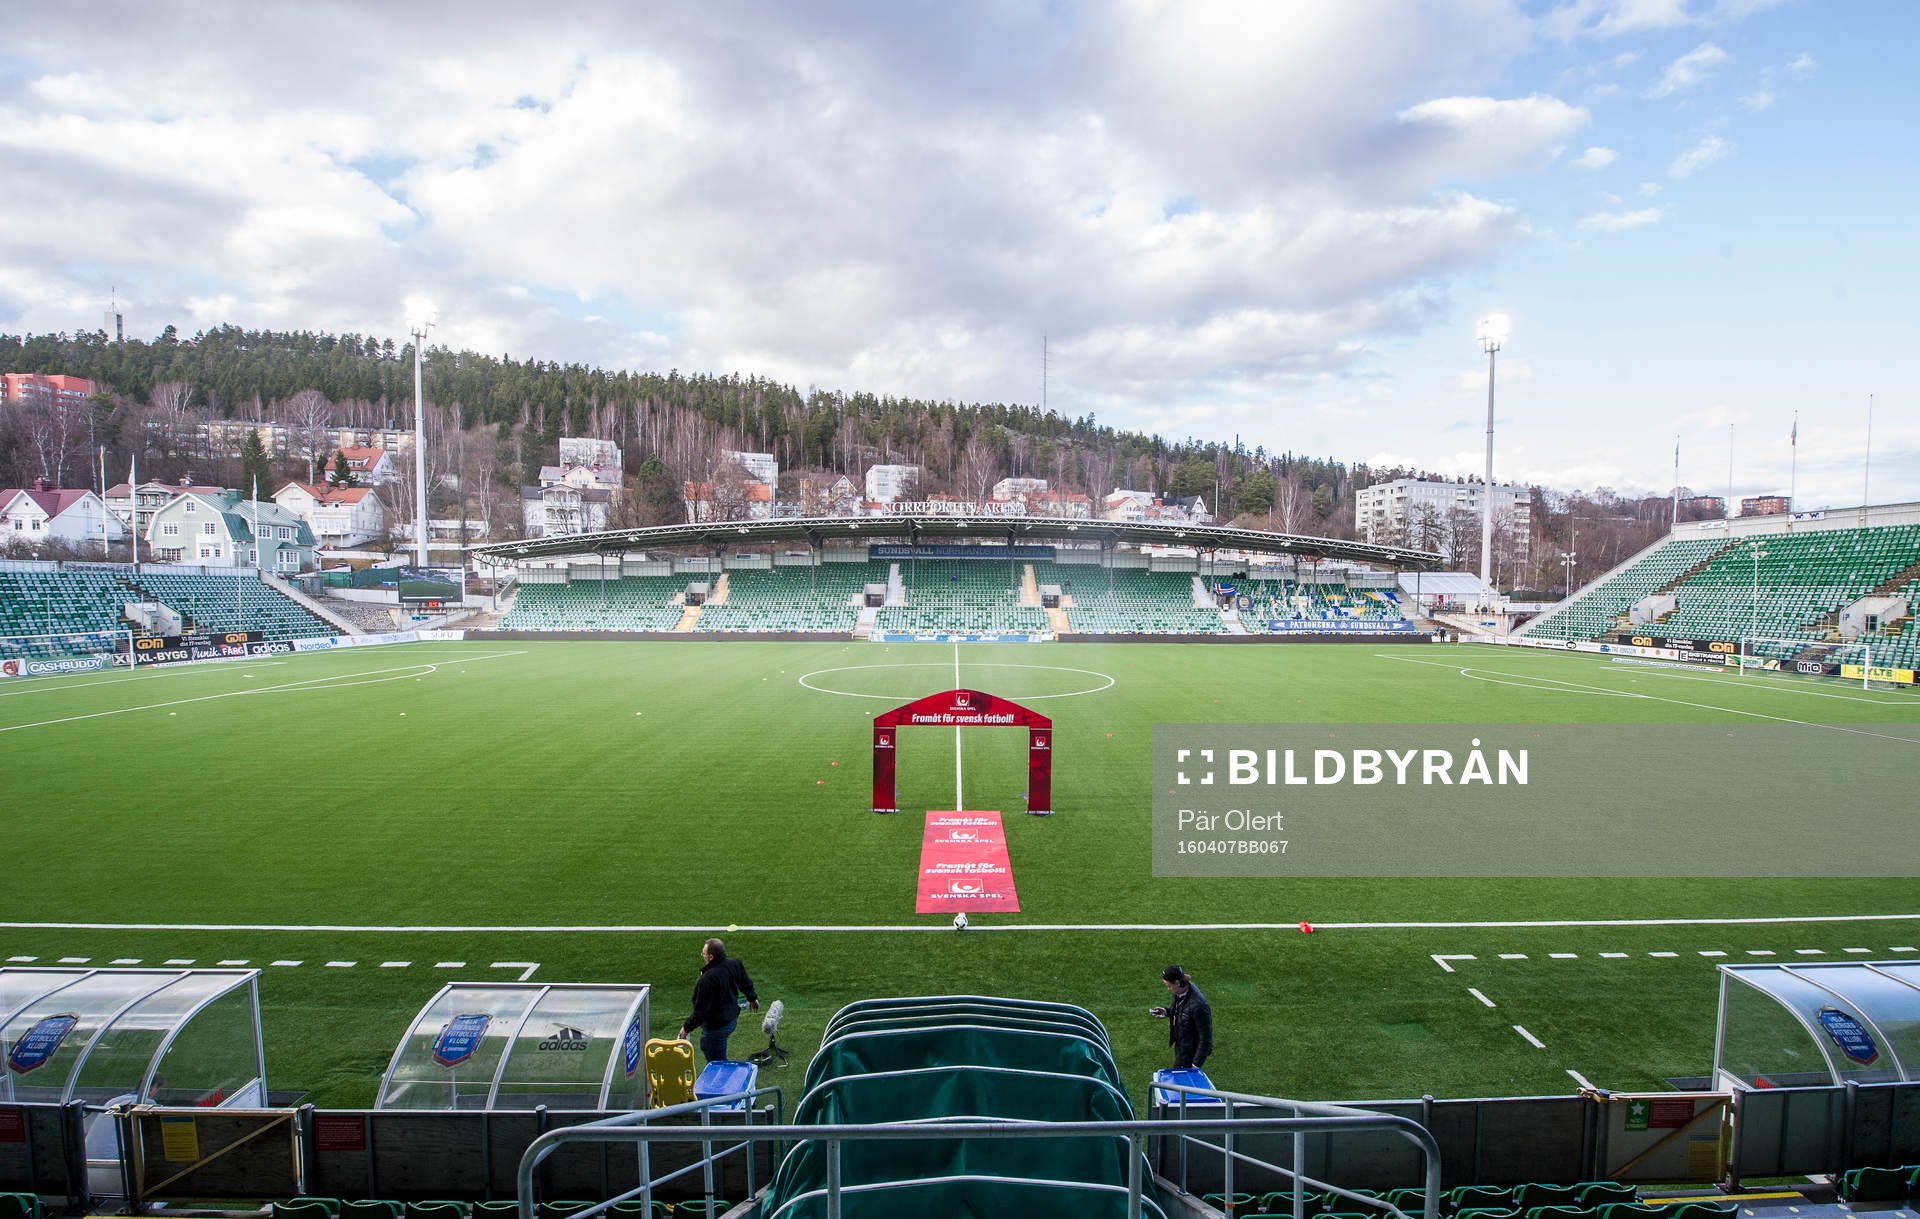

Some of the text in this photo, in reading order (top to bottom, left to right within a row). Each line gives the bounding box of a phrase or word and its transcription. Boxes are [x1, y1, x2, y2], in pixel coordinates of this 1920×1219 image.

[882, 501, 1027, 514] NORRPORTEN ARENA
[1350, 621, 1390, 630] SUNDSVALL
[252, 640, 290, 654] adidas
[300, 641, 331, 650] Nordea
[138, 650, 188, 663] XL-BYGG
[29, 659, 102, 673] CASHBUDDY
[911, 713, 1015, 724] Framåt för svensk fotboll!
[538, 1040, 588, 1051] adidas
